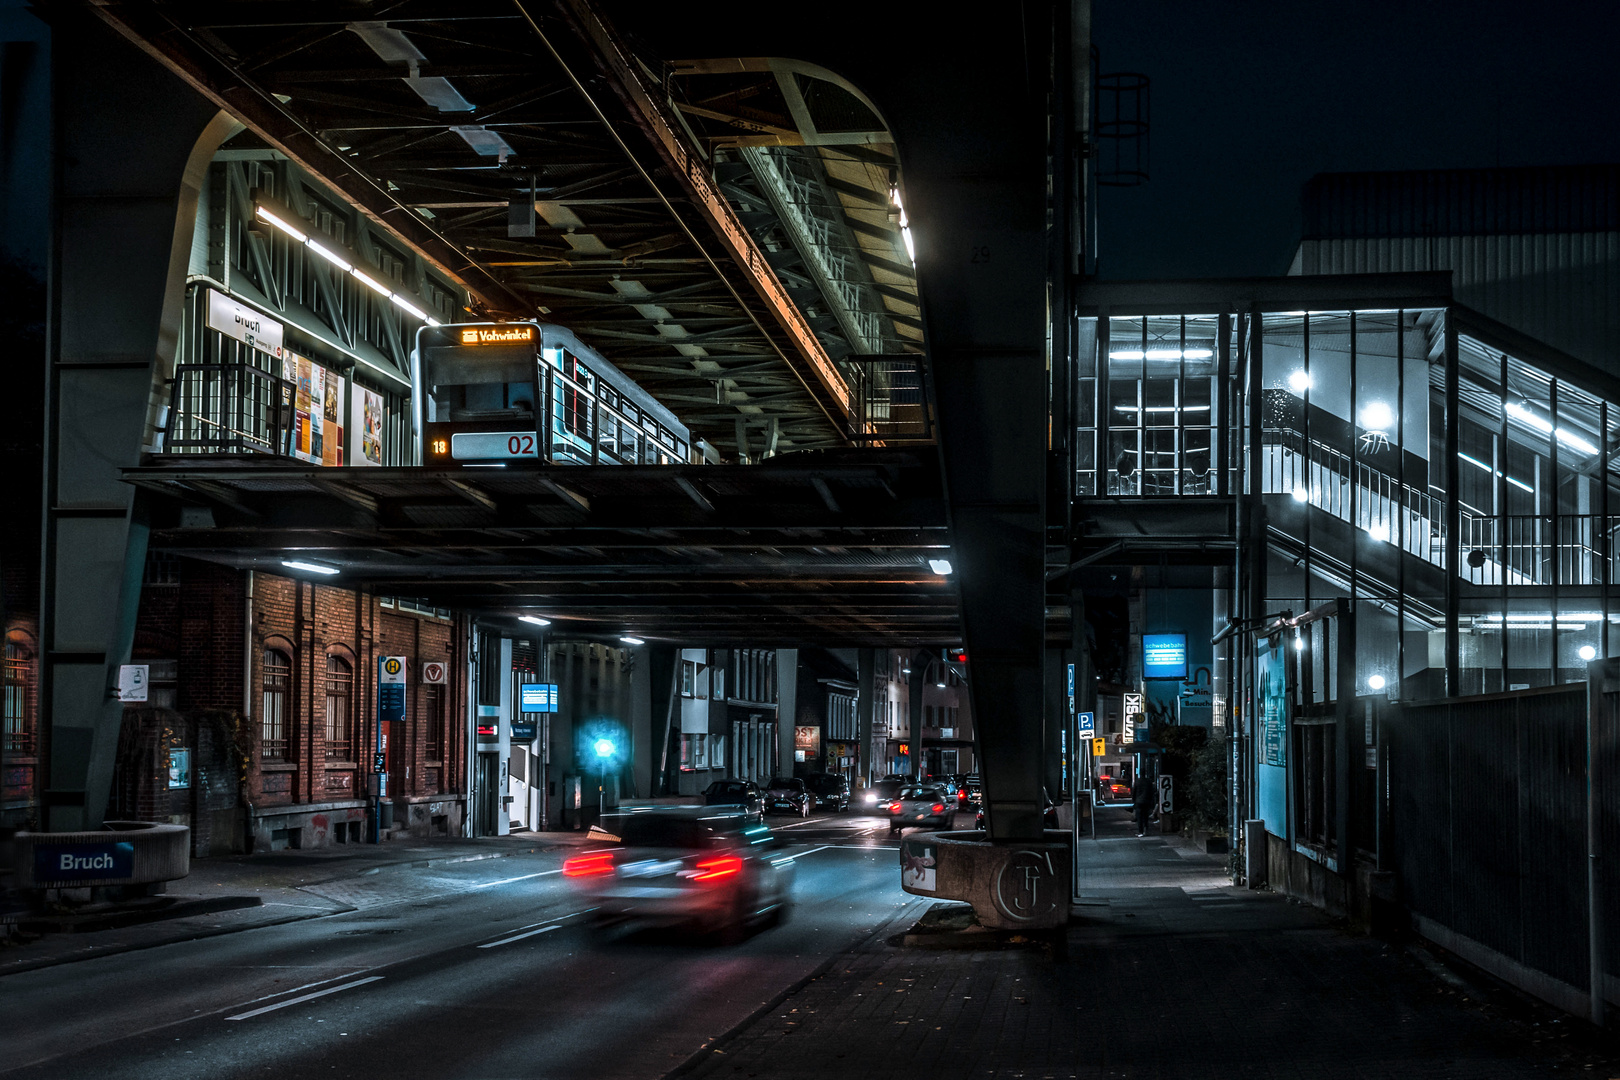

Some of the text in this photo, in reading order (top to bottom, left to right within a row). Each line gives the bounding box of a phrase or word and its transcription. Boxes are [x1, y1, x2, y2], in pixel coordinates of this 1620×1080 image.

[971, 246, 990, 263] 29
[479, 329, 531, 341] Vohwinkel
[434, 441, 446, 454] 18
[508, 436, 534, 454] 02
[1080, 715, 1089, 729] P
[60, 853, 113, 870] Bruch
